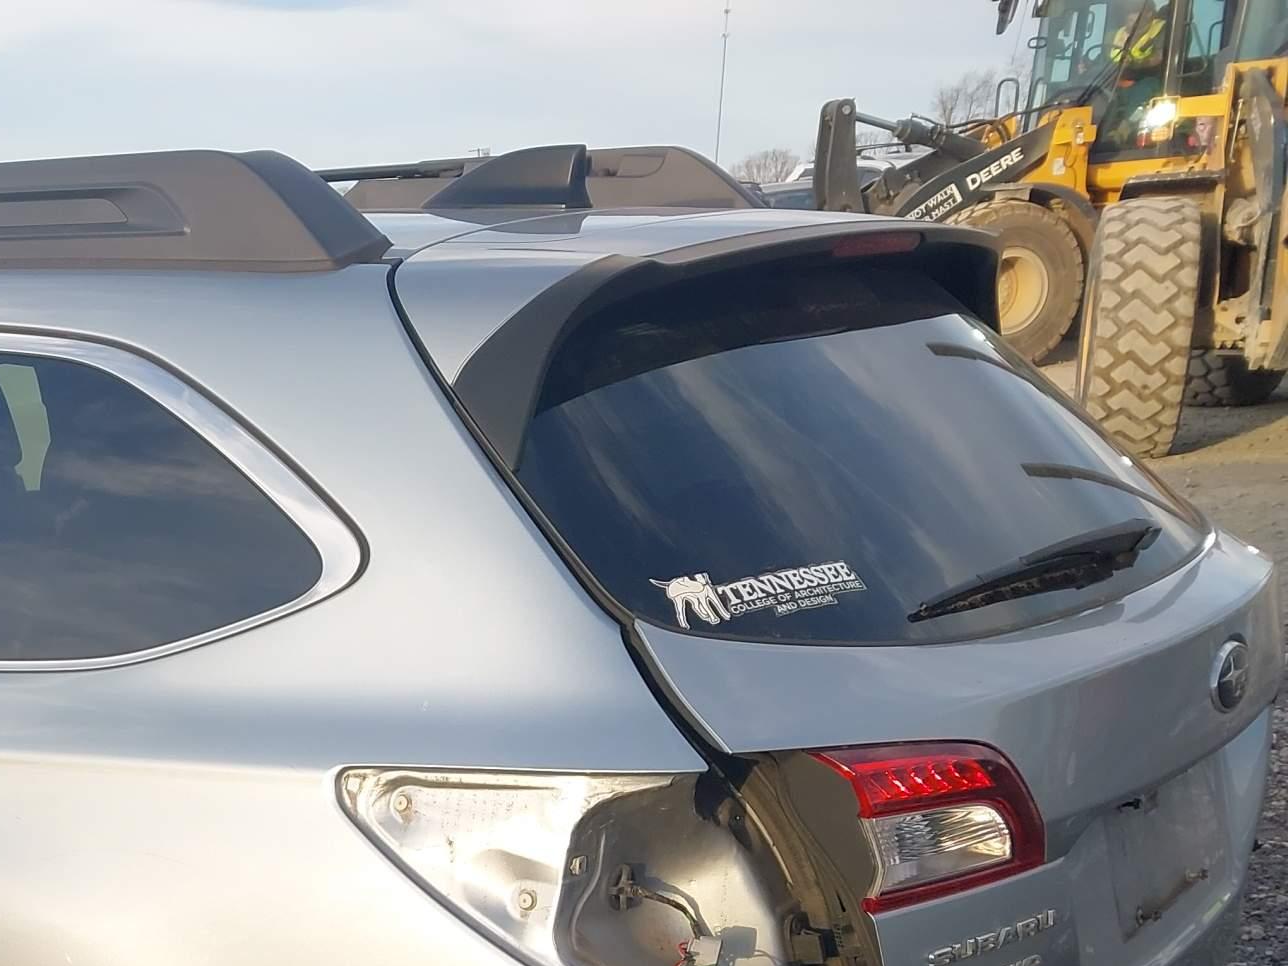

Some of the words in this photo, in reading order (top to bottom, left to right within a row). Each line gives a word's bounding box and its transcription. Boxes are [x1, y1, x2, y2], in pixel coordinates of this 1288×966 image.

[966, 147, 1024, 191] DEERE
[927, 187, 954, 207] WALK
[718, 562, 856, 604] TENNESSEE
[731, 596, 778, 614] COLLEGE
[777, 592, 793, 602] OF
[794, 580, 863, 600] ARCHITECTURE
[776, 601, 798, 613] AND
[799, 594, 834, 607] DESIGN
